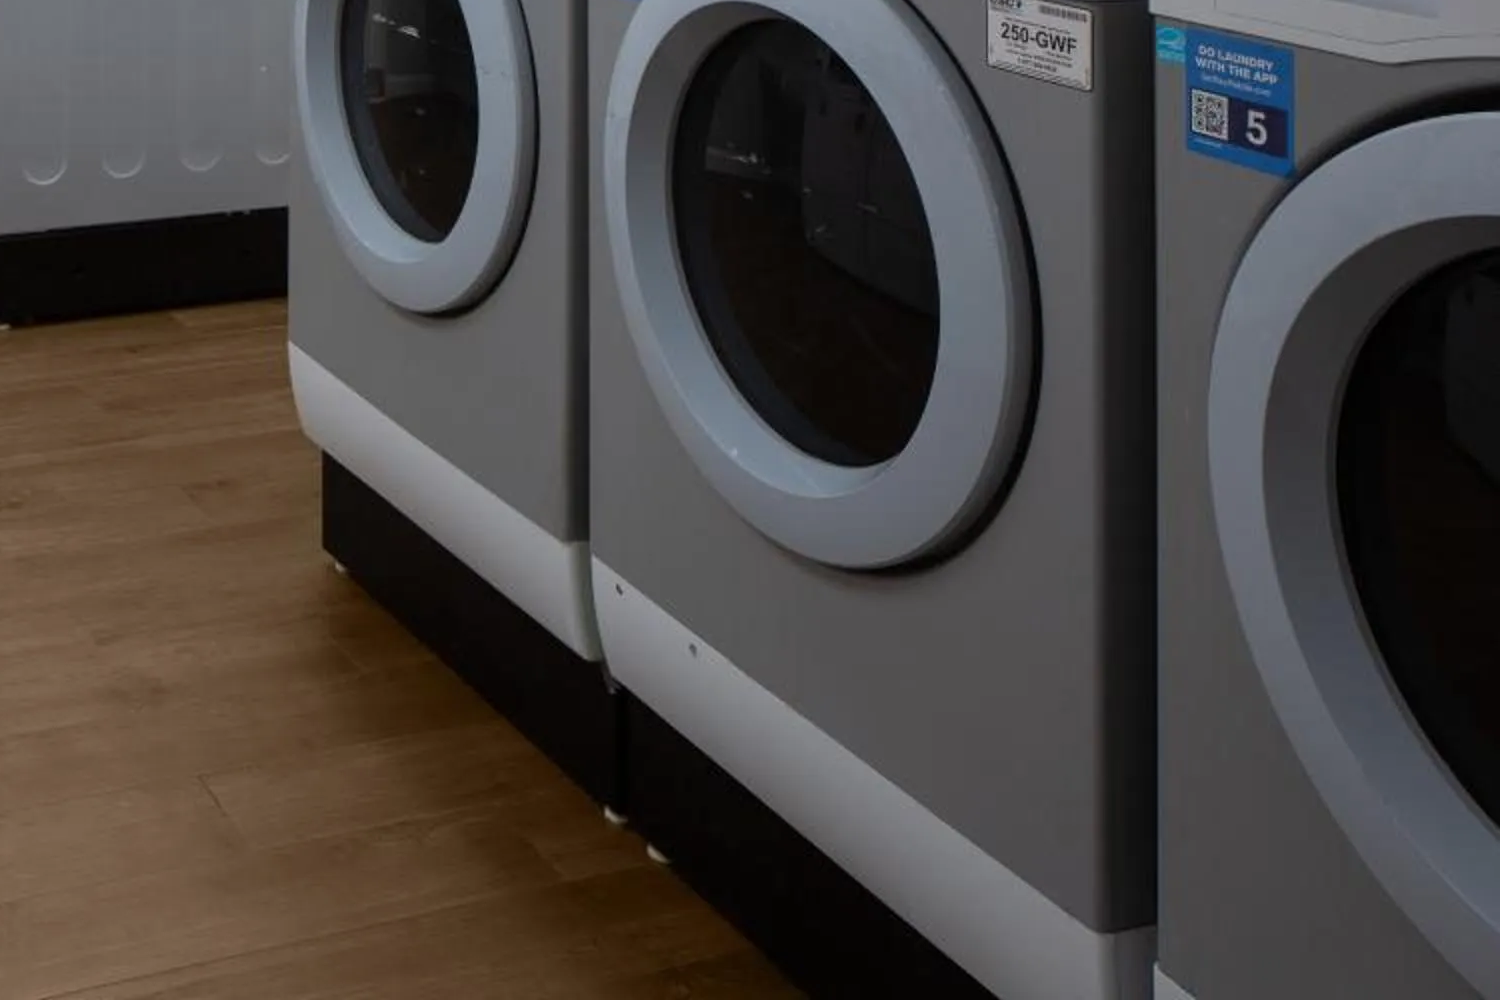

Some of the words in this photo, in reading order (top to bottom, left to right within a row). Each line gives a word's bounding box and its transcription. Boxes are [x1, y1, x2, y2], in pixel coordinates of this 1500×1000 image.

[1001, 21, 1078, 55] 250-GWF
[1195, 56, 1226, 73] WITH
[1229, 63, 1252, 80] THE
[1253, 70, 1279, 85] APP
[1198, 45, 1216, 57] DO
[1217, 50, 1275, 72] LAUNDRY
[1245, 109, 1269, 146] 5
